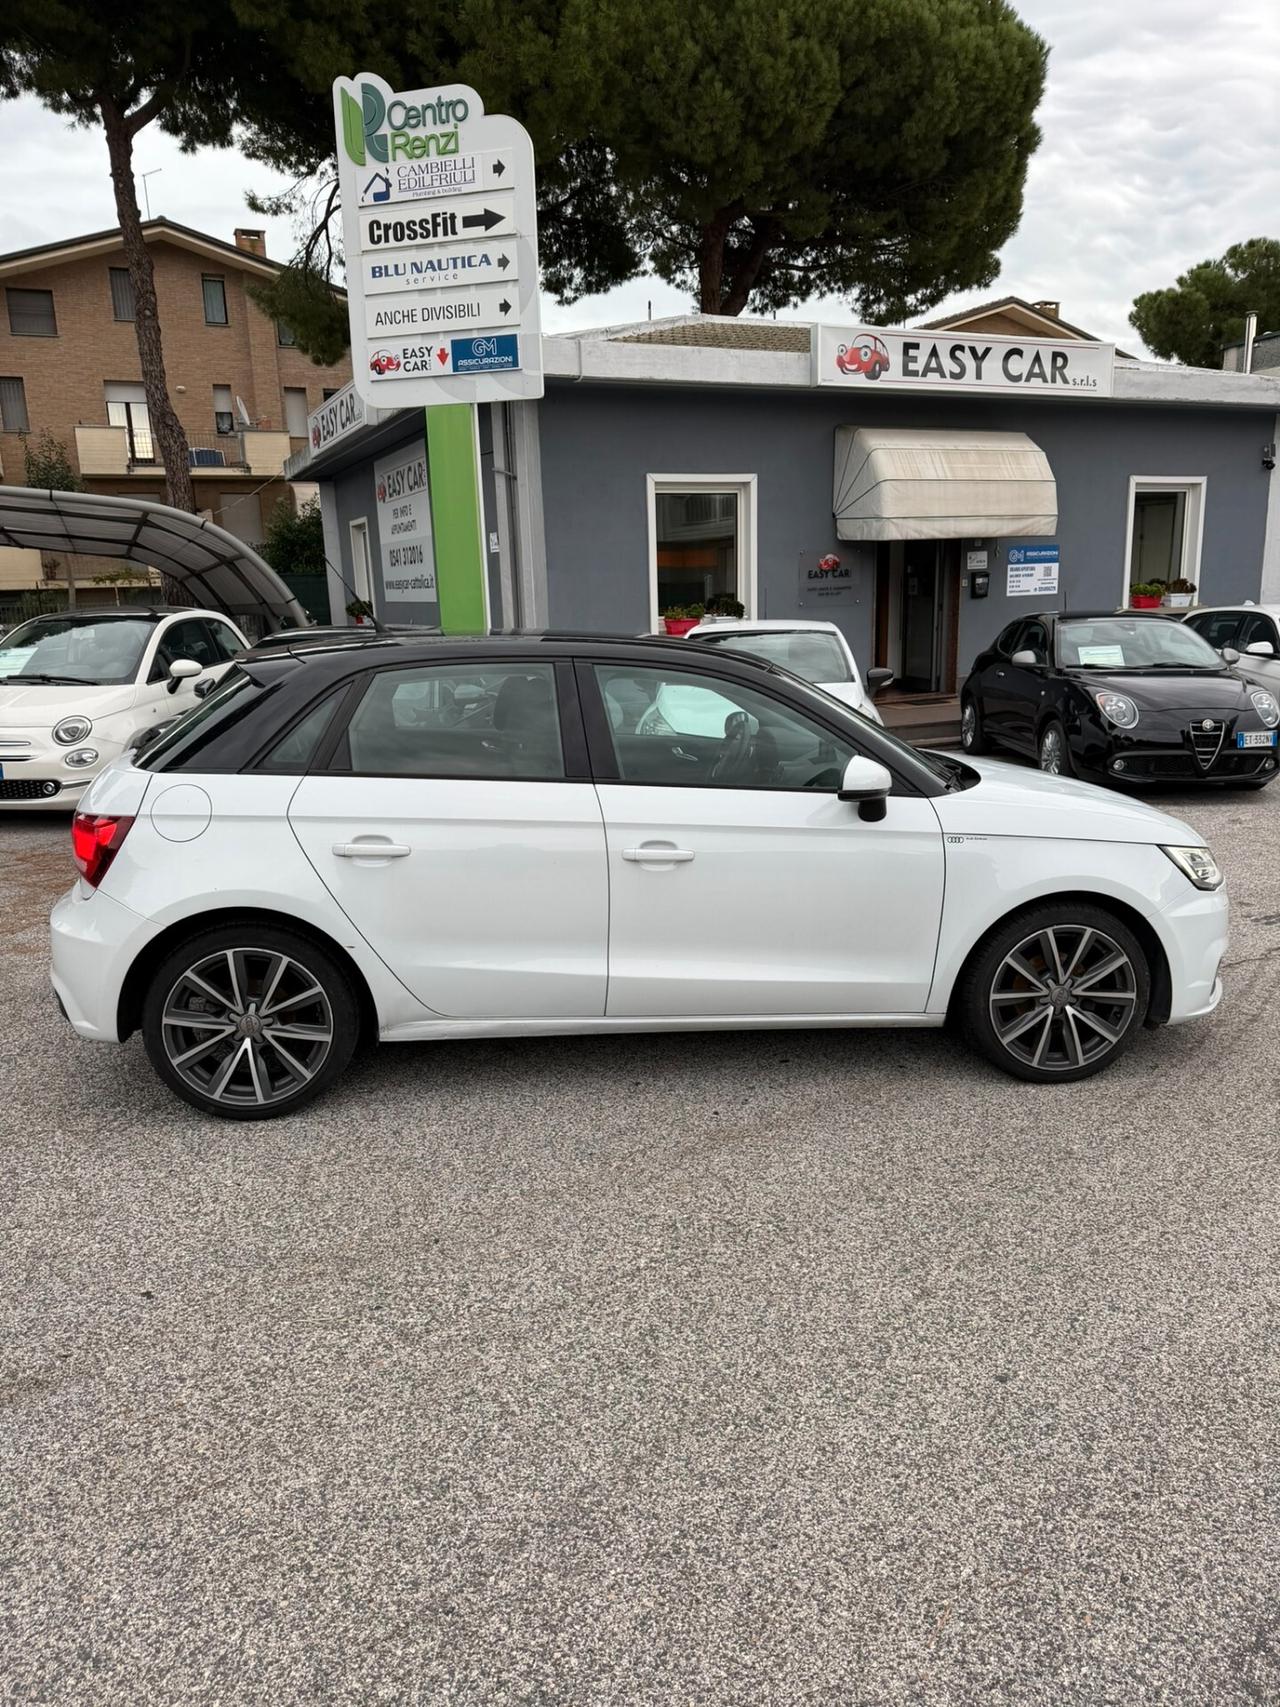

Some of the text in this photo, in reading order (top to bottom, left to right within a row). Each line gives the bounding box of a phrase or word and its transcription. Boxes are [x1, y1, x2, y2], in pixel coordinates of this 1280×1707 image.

[387, 95, 469, 131] Centro
[390, 123, 459, 162] Renzi
[397, 157, 475, 177] CAMBIELLI
[398, 170, 476, 191] EDILFRIULI
[368, 211, 458, 245] CrossFit
[371, 253, 492, 279] BLU NAUTICA
[405, 272, 458, 285] service
[375, 302, 481, 326] ANCHE DIVISIBILI
[402, 346, 433, 359] EASY
[472, 338, 497, 357] GM
[403, 360, 428, 372] CAR
[458, 356, 513, 366] ASSICURAZIONI
[902, 341, 992, 381] EASY
[1002, 347, 1070, 385] CAR
[321, 393, 356, 442] EASY CAR
[387, 468, 405, 498] EASY
[407, 462, 424, 492] CAR
